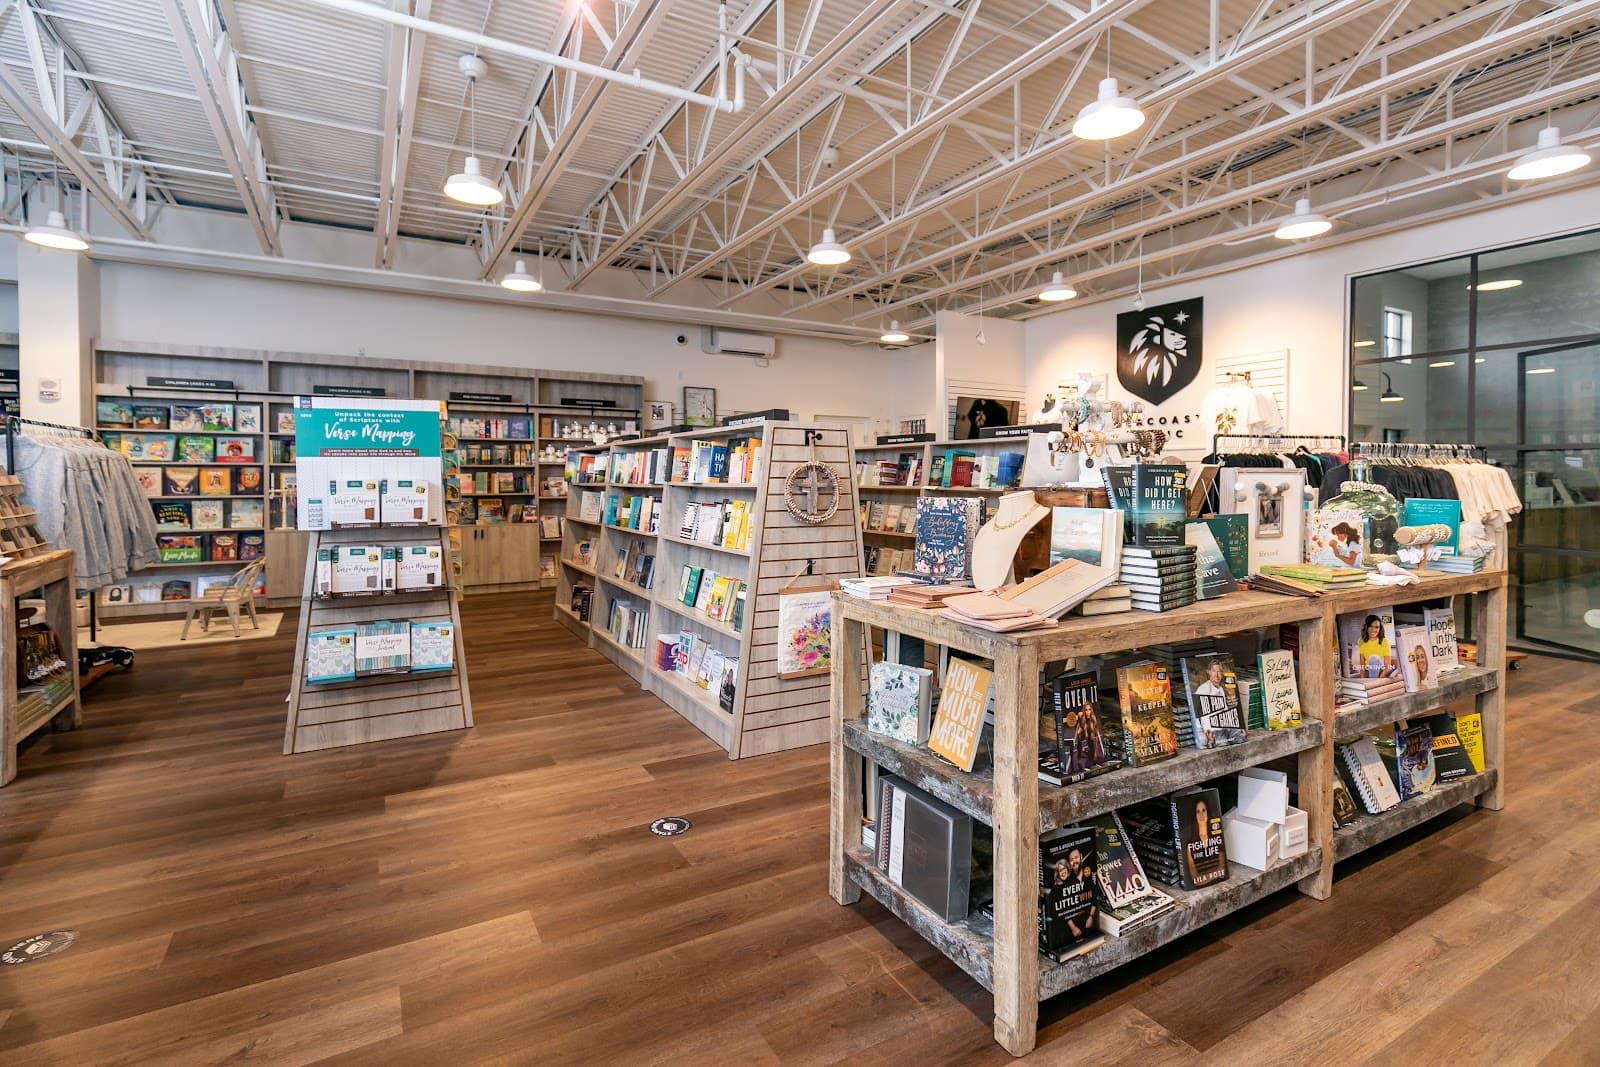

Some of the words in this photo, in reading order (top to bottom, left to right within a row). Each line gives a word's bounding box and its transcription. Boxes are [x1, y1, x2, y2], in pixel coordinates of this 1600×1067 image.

[1128, 414, 1200, 426] ACOAS
[324, 422, 358, 440] Verse
[361, 423, 416, 446] Mapping
[1155, 476, 1172, 486] HOW
[1145, 488, 1158, 498] DID
[1162, 488, 1164, 497] I
[1167, 488, 1181, 498] GET
[1152, 500, 1175, 510] HERE?
[1199, 554, 1214, 565] the
[1195, 567, 1220, 578] Cave
[1431, 619, 1452, 632] Hop
[1437, 633, 1443, 644] in
[1445, 631, 1457, 642] the
[1432, 645, 1453, 657] Dark
[1265, 659, 1274, 673] So
[1276, 657, 1291, 670] Long
[946, 661, 979, 697] HOW
[1267, 671, 1292, 684] Normal
[1064, 688, 1087, 709] OVER
[1090, 686, 1098, 704] IT
[1271, 687, 1293, 702] Laura
[941, 688, 981, 731] MUCH
[1138, 700, 1166, 712] KEEPER
[1200, 696, 1210, 715] NO
[1210, 715, 1219, 728] NO
[1219, 708, 1239, 728] GAINES
[932, 712, 973, 760] MORE
[1141, 742, 1174, 756] MARTIN
[1170, 802, 1180, 830] FIGHTING
[1187, 836, 1222, 853] FIGHTING
[1204, 846, 1220, 857] LIFE
[1097, 851, 1109, 861] he
[1097, 858, 1122, 873] Power
[1193, 874, 1206, 884] LILA
[1209, 869, 1225, 878] ROSE
[1062, 882, 1085, 897] EVERY
[1108, 874, 1145, 902] 1440
[1055, 895, 1079, 910] LITTLE
